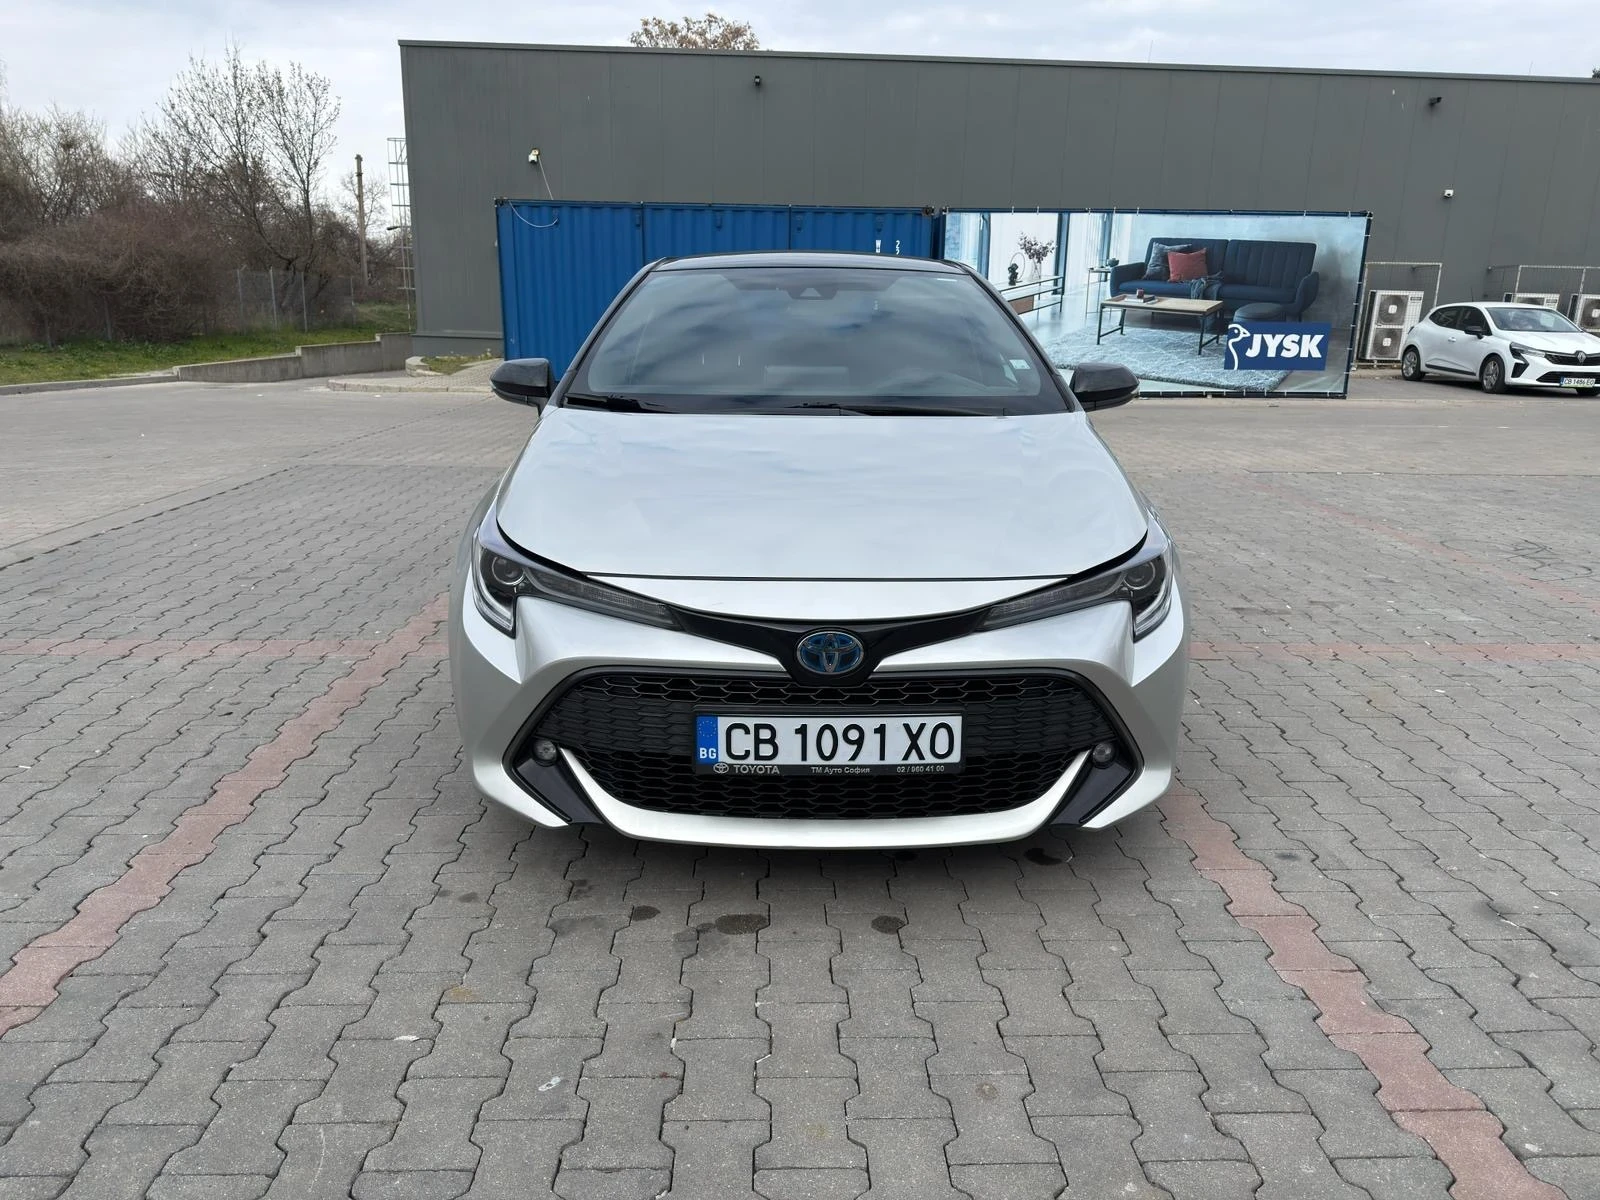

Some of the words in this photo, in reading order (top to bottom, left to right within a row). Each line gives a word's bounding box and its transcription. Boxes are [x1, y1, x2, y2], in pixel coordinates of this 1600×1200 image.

[1245, 333, 1325, 358] JYSK
[725, 722, 779, 761] CB
[794, 723, 887, 762] 1091
[901, 722, 955, 761] XO
[699, 747, 717, 759] BG
[733, 764, 780, 775] TOYOTA
[824, 766, 843, 775] Ауто
[844, 766, 871, 775] София
[925, 765, 935, 773] 41
[935, 764, 945, 773] 00
